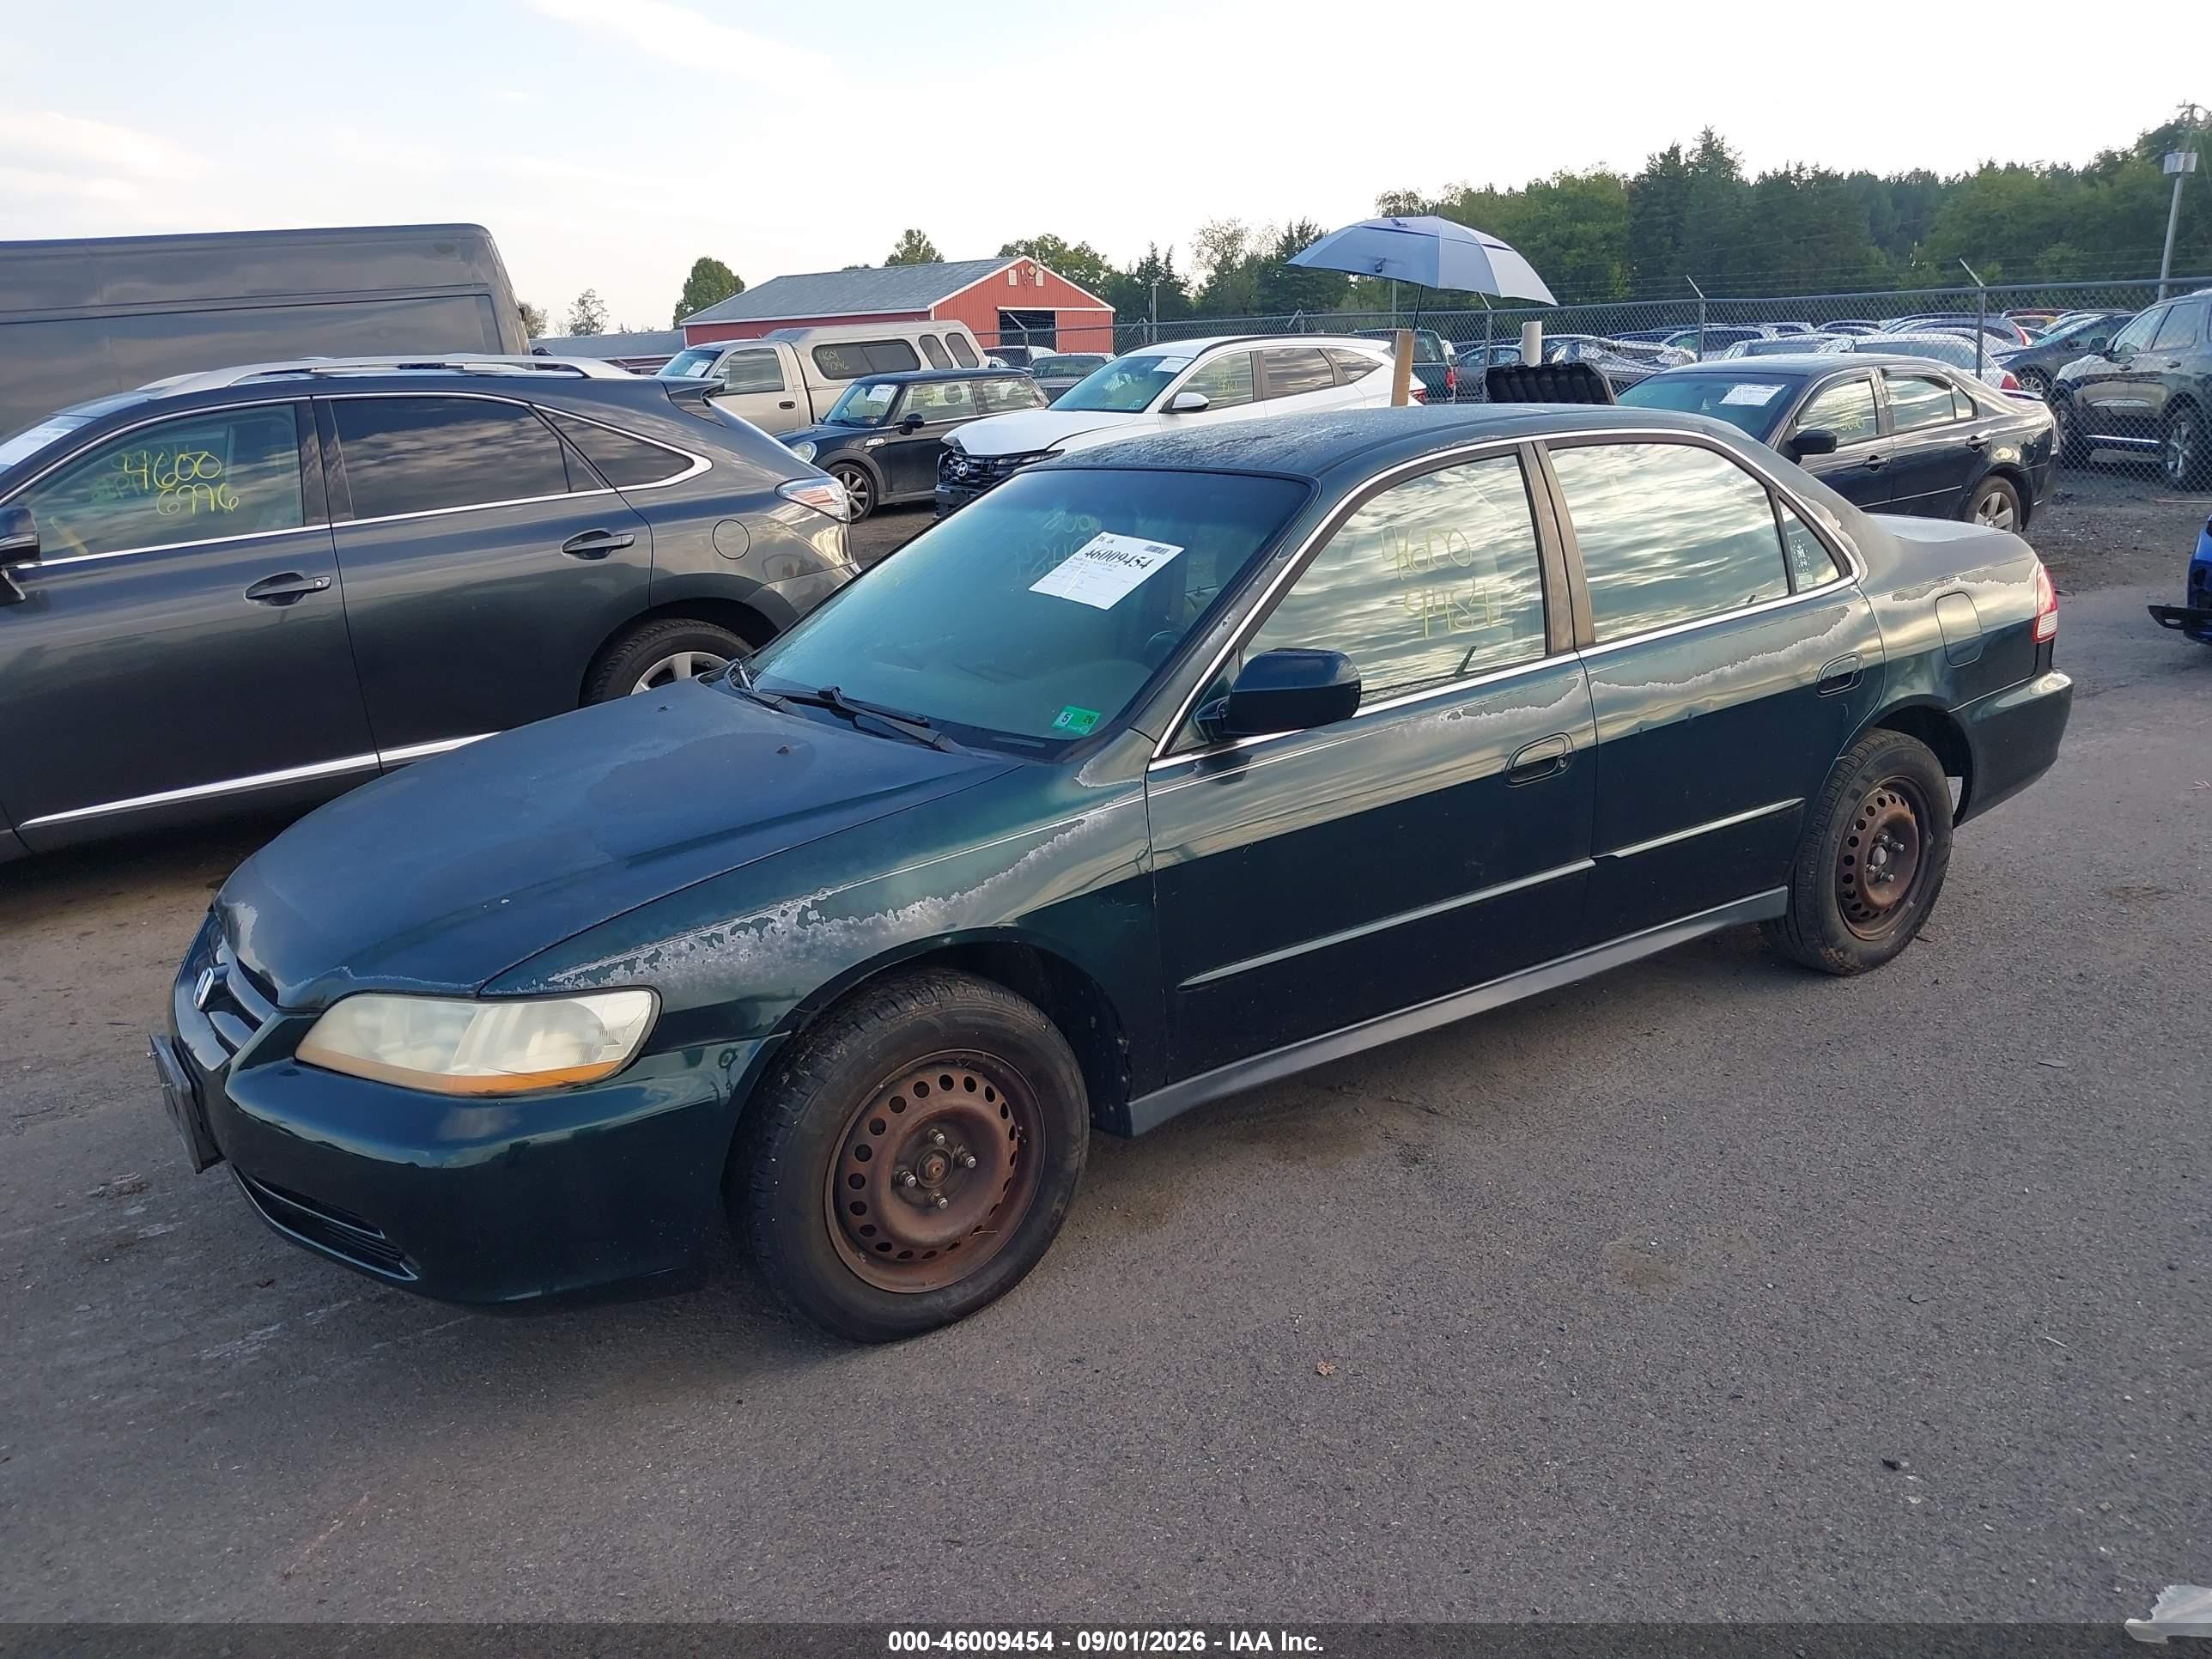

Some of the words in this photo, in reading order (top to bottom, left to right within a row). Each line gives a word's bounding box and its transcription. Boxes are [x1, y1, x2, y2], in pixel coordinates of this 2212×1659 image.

[122, 451, 222, 489] 4600
[1085, 546, 1155, 570] 46009454
[1380, 526, 1472, 581] 4600
[1061, 713, 1072, 723] 5
[1083, 714, 1096, 725] 26
